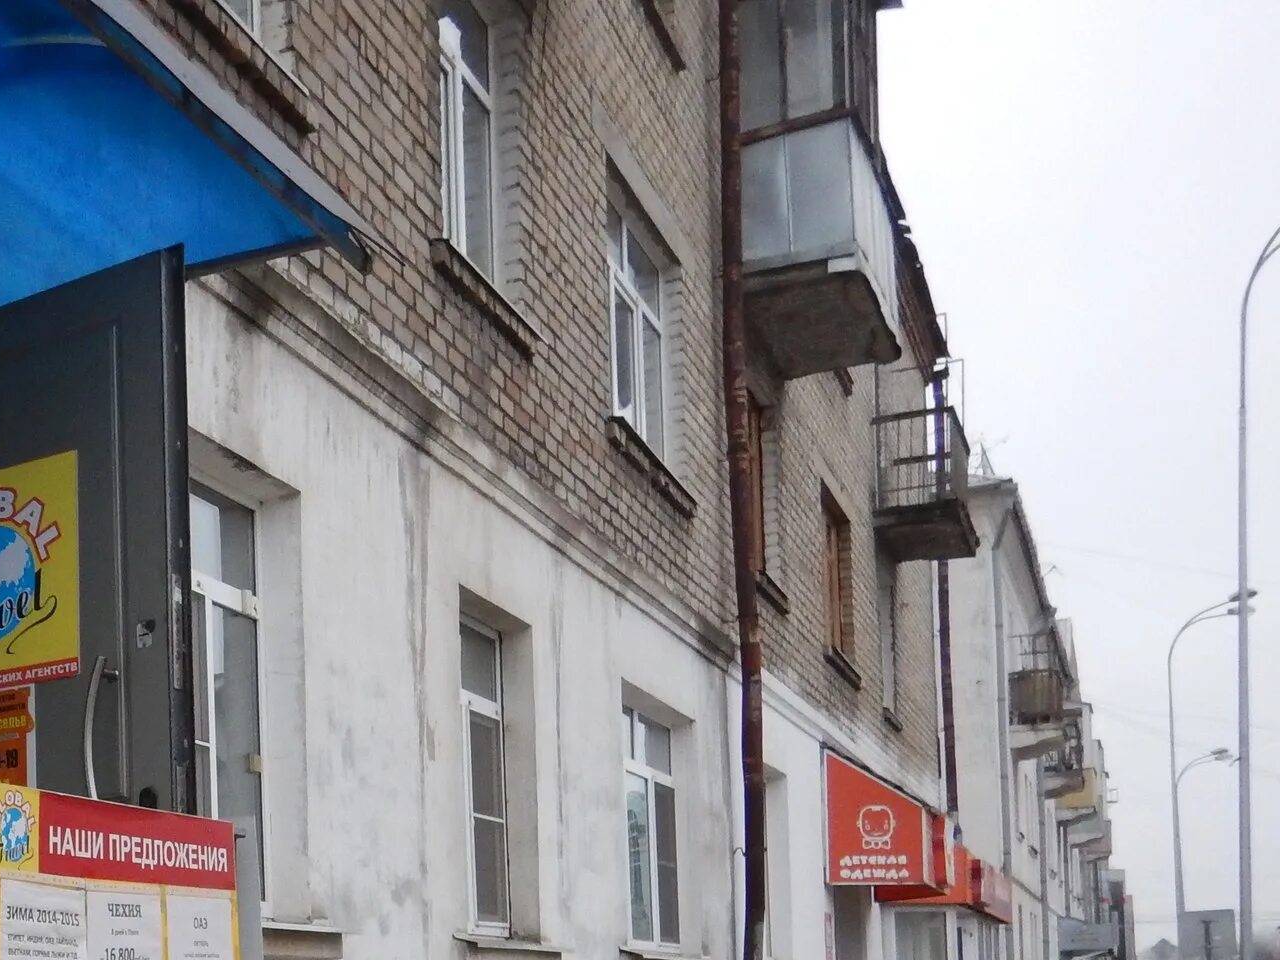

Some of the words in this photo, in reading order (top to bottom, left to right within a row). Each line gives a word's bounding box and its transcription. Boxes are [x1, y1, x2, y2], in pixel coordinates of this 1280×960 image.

[24, 661, 78, 680] АГЕНТСТВ
[49, 825, 104, 859] НАШИ
[109, 833, 228, 873] ПРЕДЛОЖЕНИЯ
[839, 855, 907, 867] ДЕТСКАЯ
[839, 869, 909, 880] ОДЕЖДА
[6, 905, 34, 923] ЗИМА
[36, 909, 80, 927] 2014-2015
[107, 903, 142, 918] ЧЕХИЯ
[193, 917, 208, 930] ОАЭ
